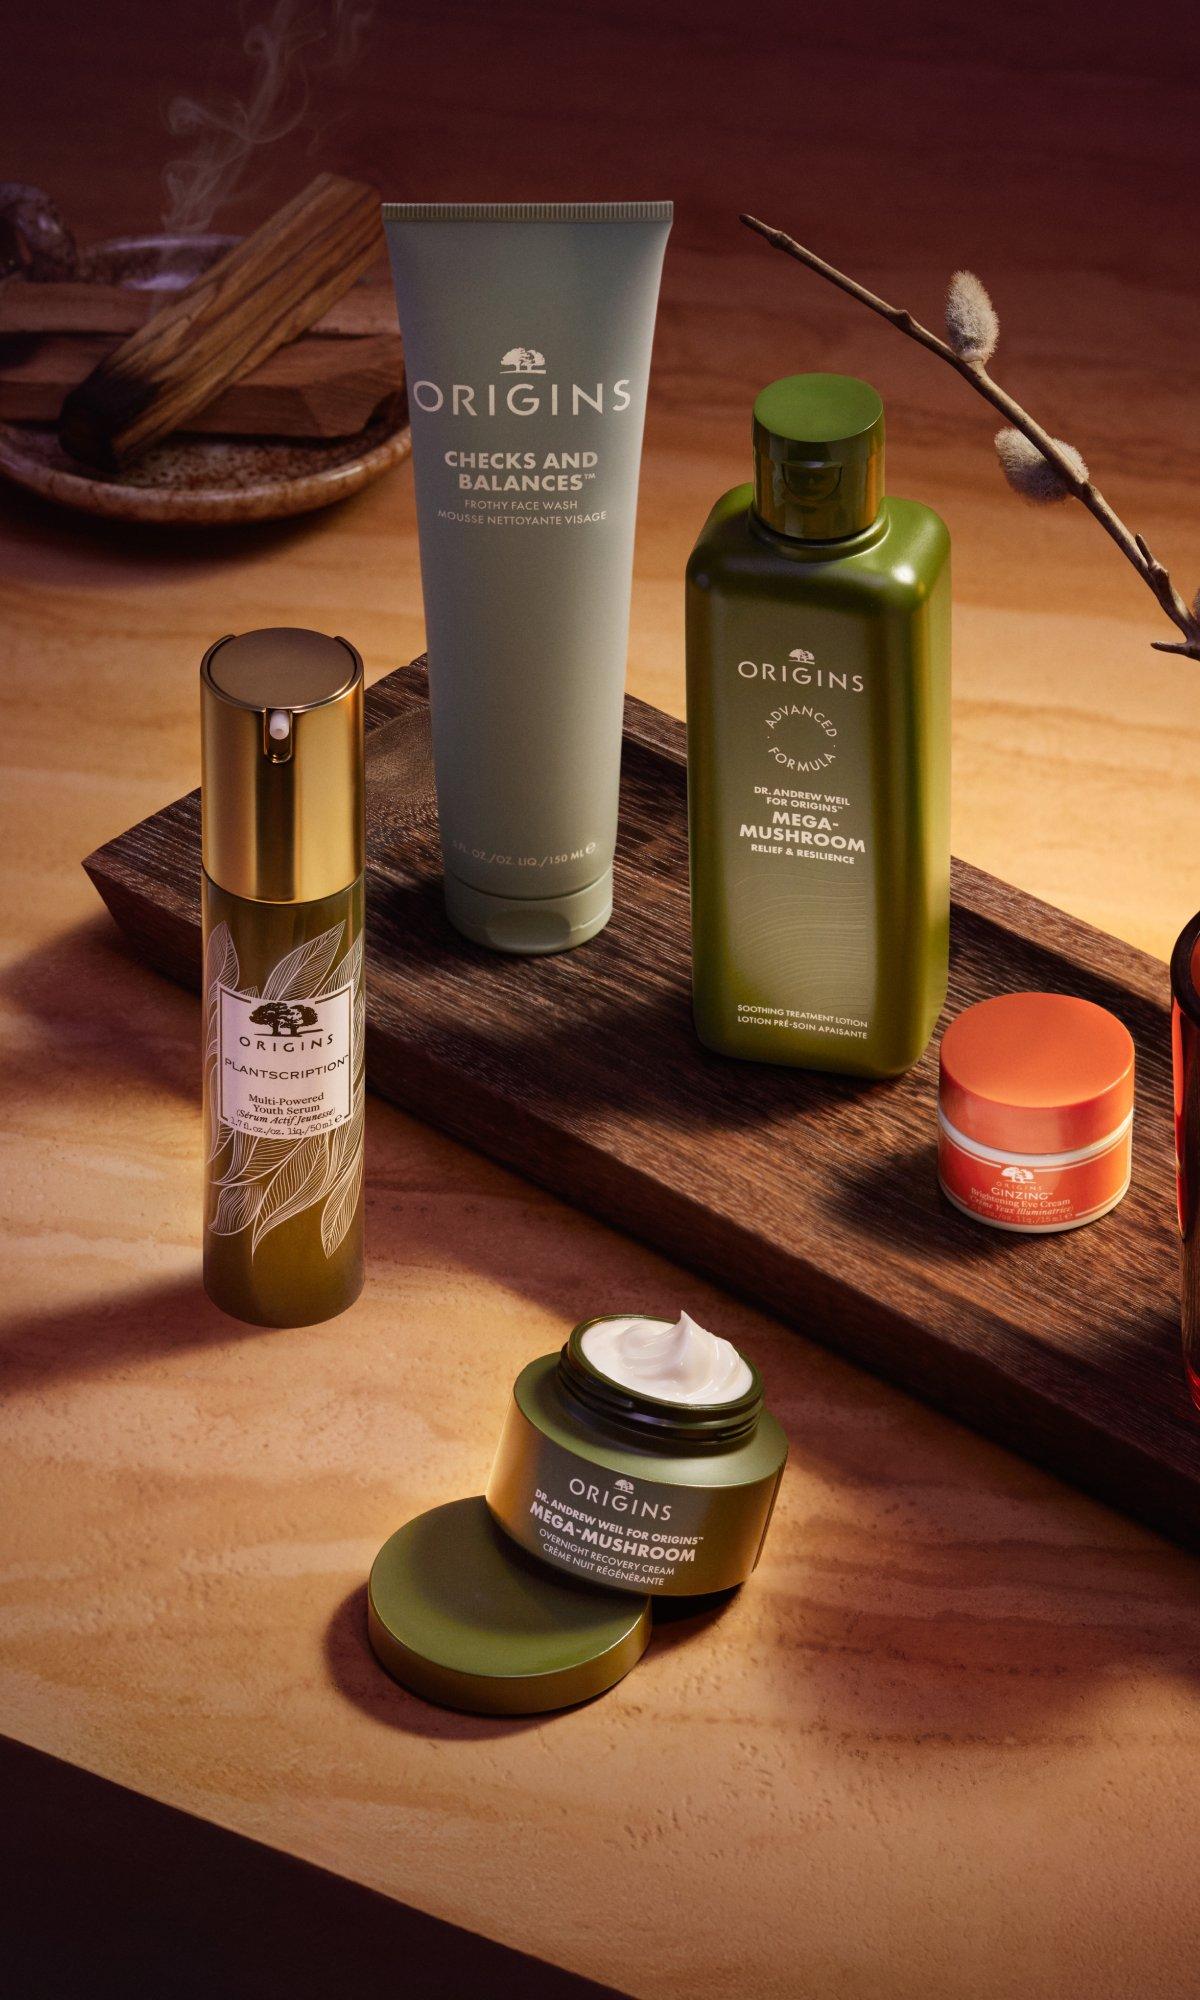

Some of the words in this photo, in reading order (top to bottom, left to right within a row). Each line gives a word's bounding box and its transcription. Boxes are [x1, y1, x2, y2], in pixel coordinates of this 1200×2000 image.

[412, 379, 631, 417] ORIGINS
[444, 450, 537, 470] CHECKS
[542, 450, 599, 470] AND
[464, 499, 508, 511] FROTHY
[511, 500, 540, 511] FACE
[542, 500, 578, 510] WASH
[437, 509, 485, 525] MOUSSE
[487, 514, 562, 526] NETTOYANTE
[565, 510, 608, 525] VISAGE
[737, 660, 865, 692] ORIGINS
[765, 704, 838, 738] ADVANCED
[767, 746, 836, 772] FORMULA
[754, 786, 772, 795] DR.
[773, 788, 822, 802] ANDREW
[823, 794, 851, 806] WEIL
[766, 796, 788, 806] FOR
[772, 811, 839, 831] MEGA-
[739, 824, 866, 853] MUSHROOM
[750, 843, 783, 855] RELIEF
[785, 848, 794, 856] &
[796, 849, 855, 865] RESILIENCE
[737, 1004, 785, 1016] SOOTHING
[785, 1009, 835, 1023] TREATMENT
[835, 1016, 868, 1028] LOTION
[737, 1015, 772, 1026] LOTION
[773, 1019, 816, 1032] PRÉ-SOIN
[818, 1026, 868, 1039] APAISANTE
[239, 1033, 334, 1053] ORIGINS
[248, 1092, 325, 1106] Multi-Powered
[252, 1104, 284, 1115] Youth
[286, 1104, 320, 1115] Serum
[269, 1115, 296, 1126] Actif
[1021, 1200, 1039, 1209] Eye
[1040, 1198, 1071, 1208] Cream
[569, 1478, 672, 1521] ORIGINS
[534, 1488, 549, 1504] DR.
[550, 1499, 597, 1526] ANDREW
[598, 1519, 624, 1536] WEIL
[626, 1527, 649, 1541] FOR
[529, 1500, 696, 1563] MEGA-MUSHROOM
[539, 1528, 590, 1558] OVERNIGHT
[590, 1551, 641, 1571] RECOVERY
[641, 1564, 675, 1576] CREAM
[542, 1543, 572, 1563] CRÈME
[572, 1556, 596, 1572] NUIT
[596, 1564, 665, 1586] RÉGÉNÉRANTE
